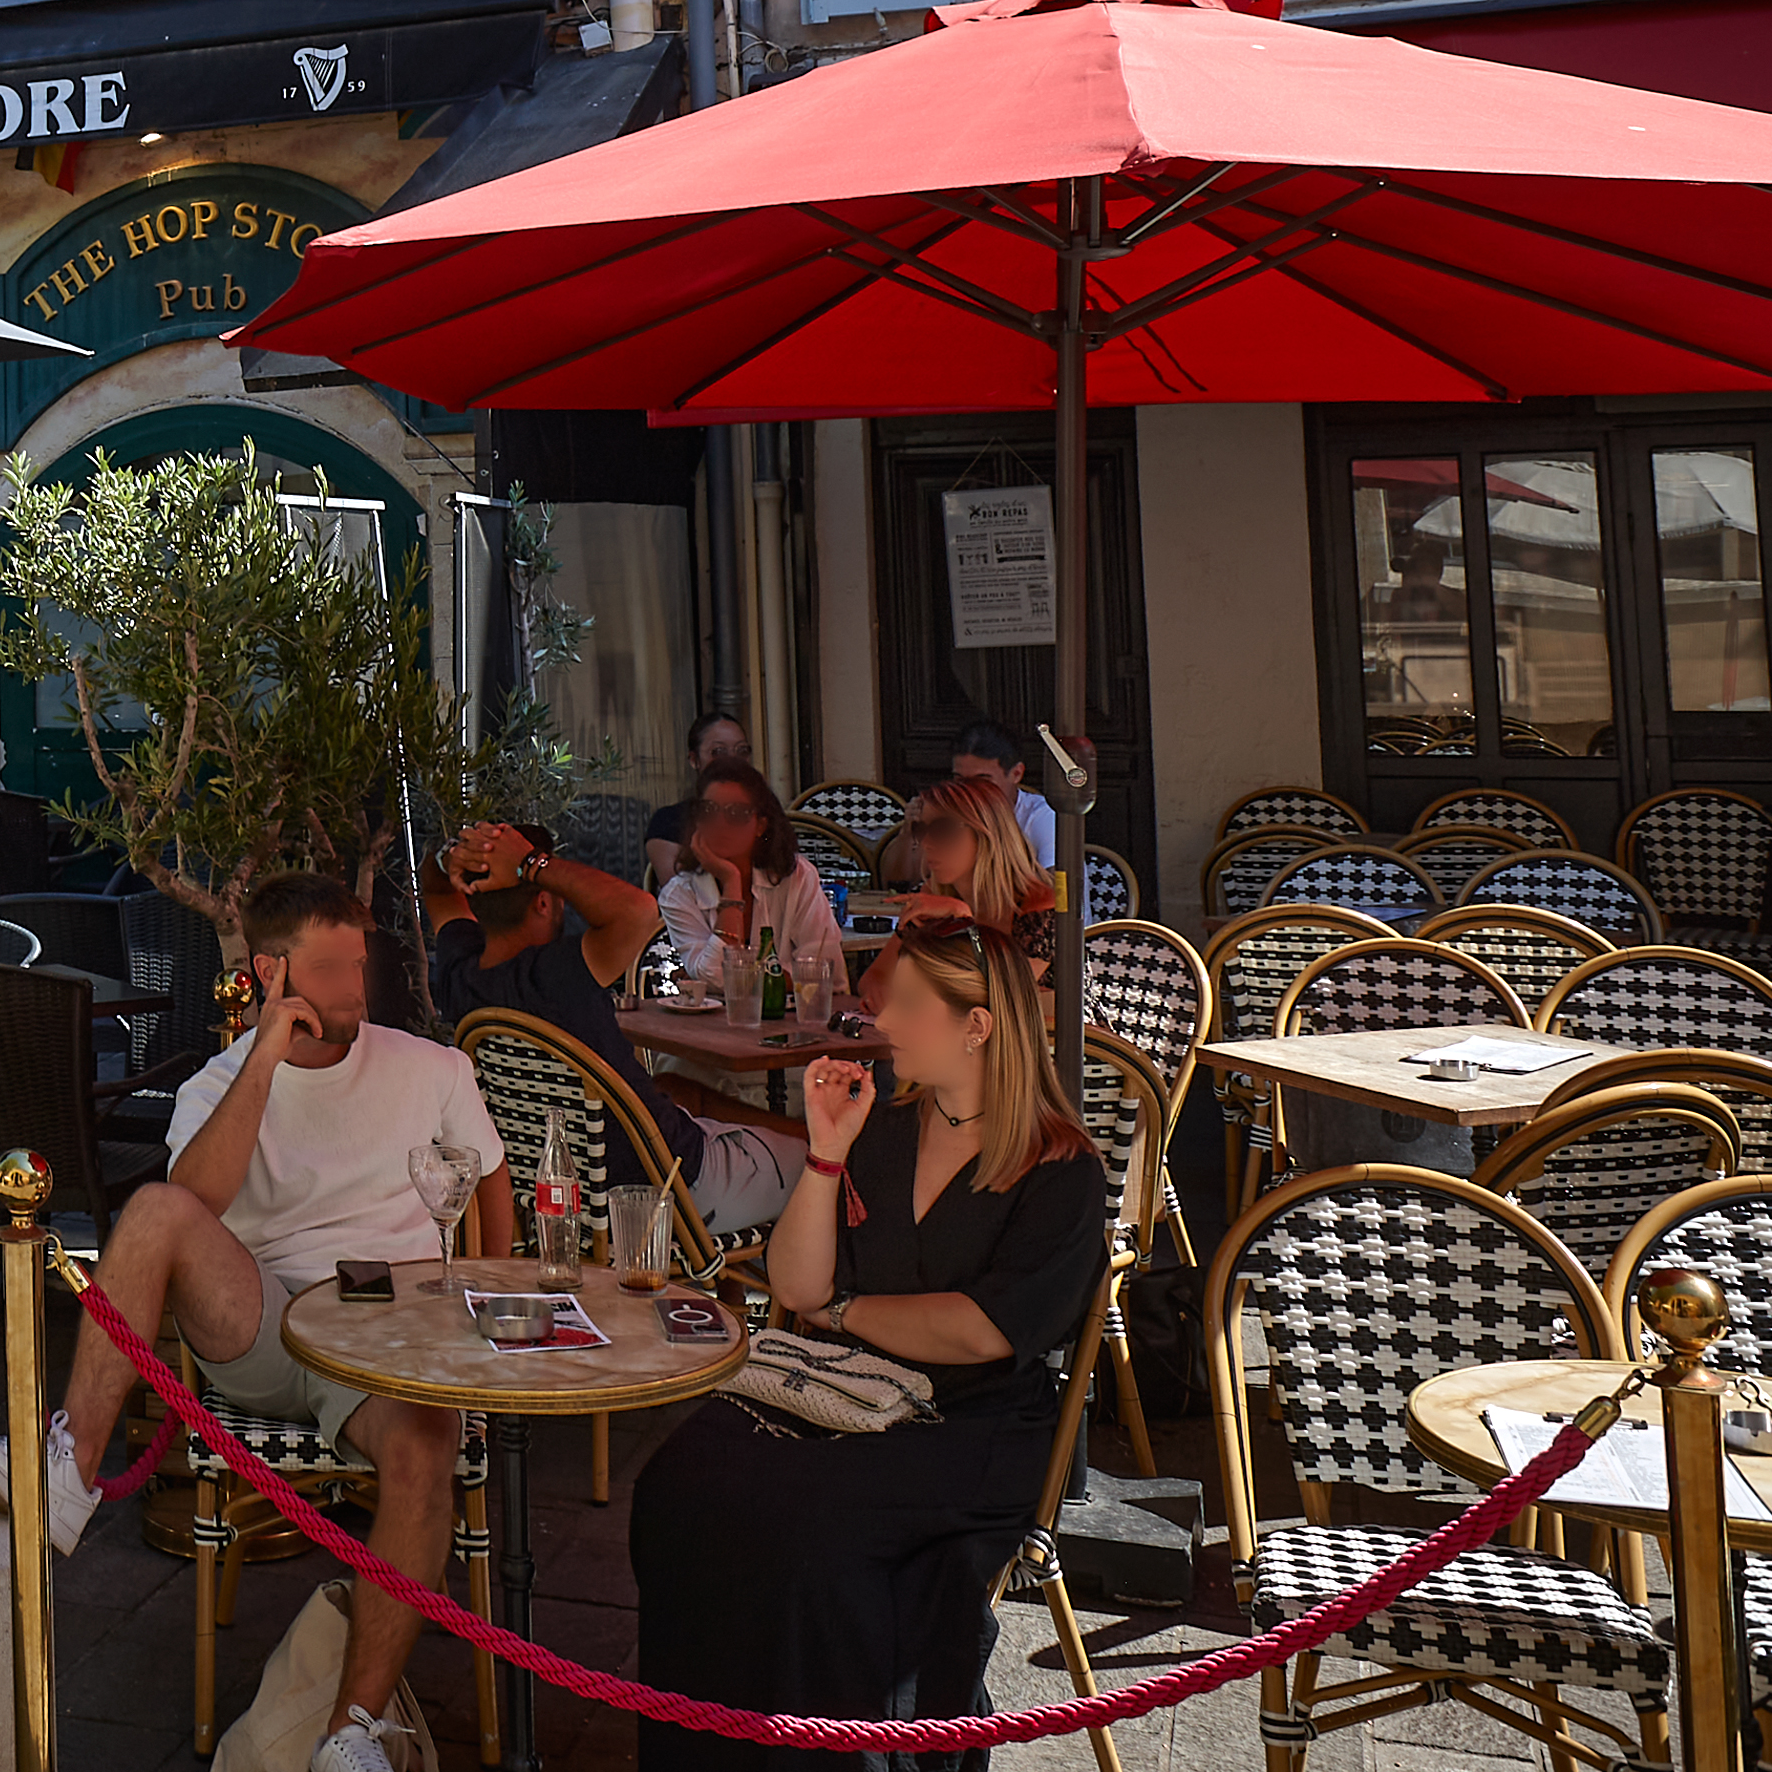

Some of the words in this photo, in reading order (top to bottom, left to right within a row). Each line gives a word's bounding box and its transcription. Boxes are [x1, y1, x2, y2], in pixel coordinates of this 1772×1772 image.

[282, 87, 297, 100] 17
[347, 79, 366, 93] 59
[23, 239, 115, 323] THE
[120, 200, 220, 259] HOP
[231, 201, 323, 260] STO
[155, 273, 247, 319] Pub
[982, 508, 998, 519] BON
[1002, 507, 1028, 517] REPAS
